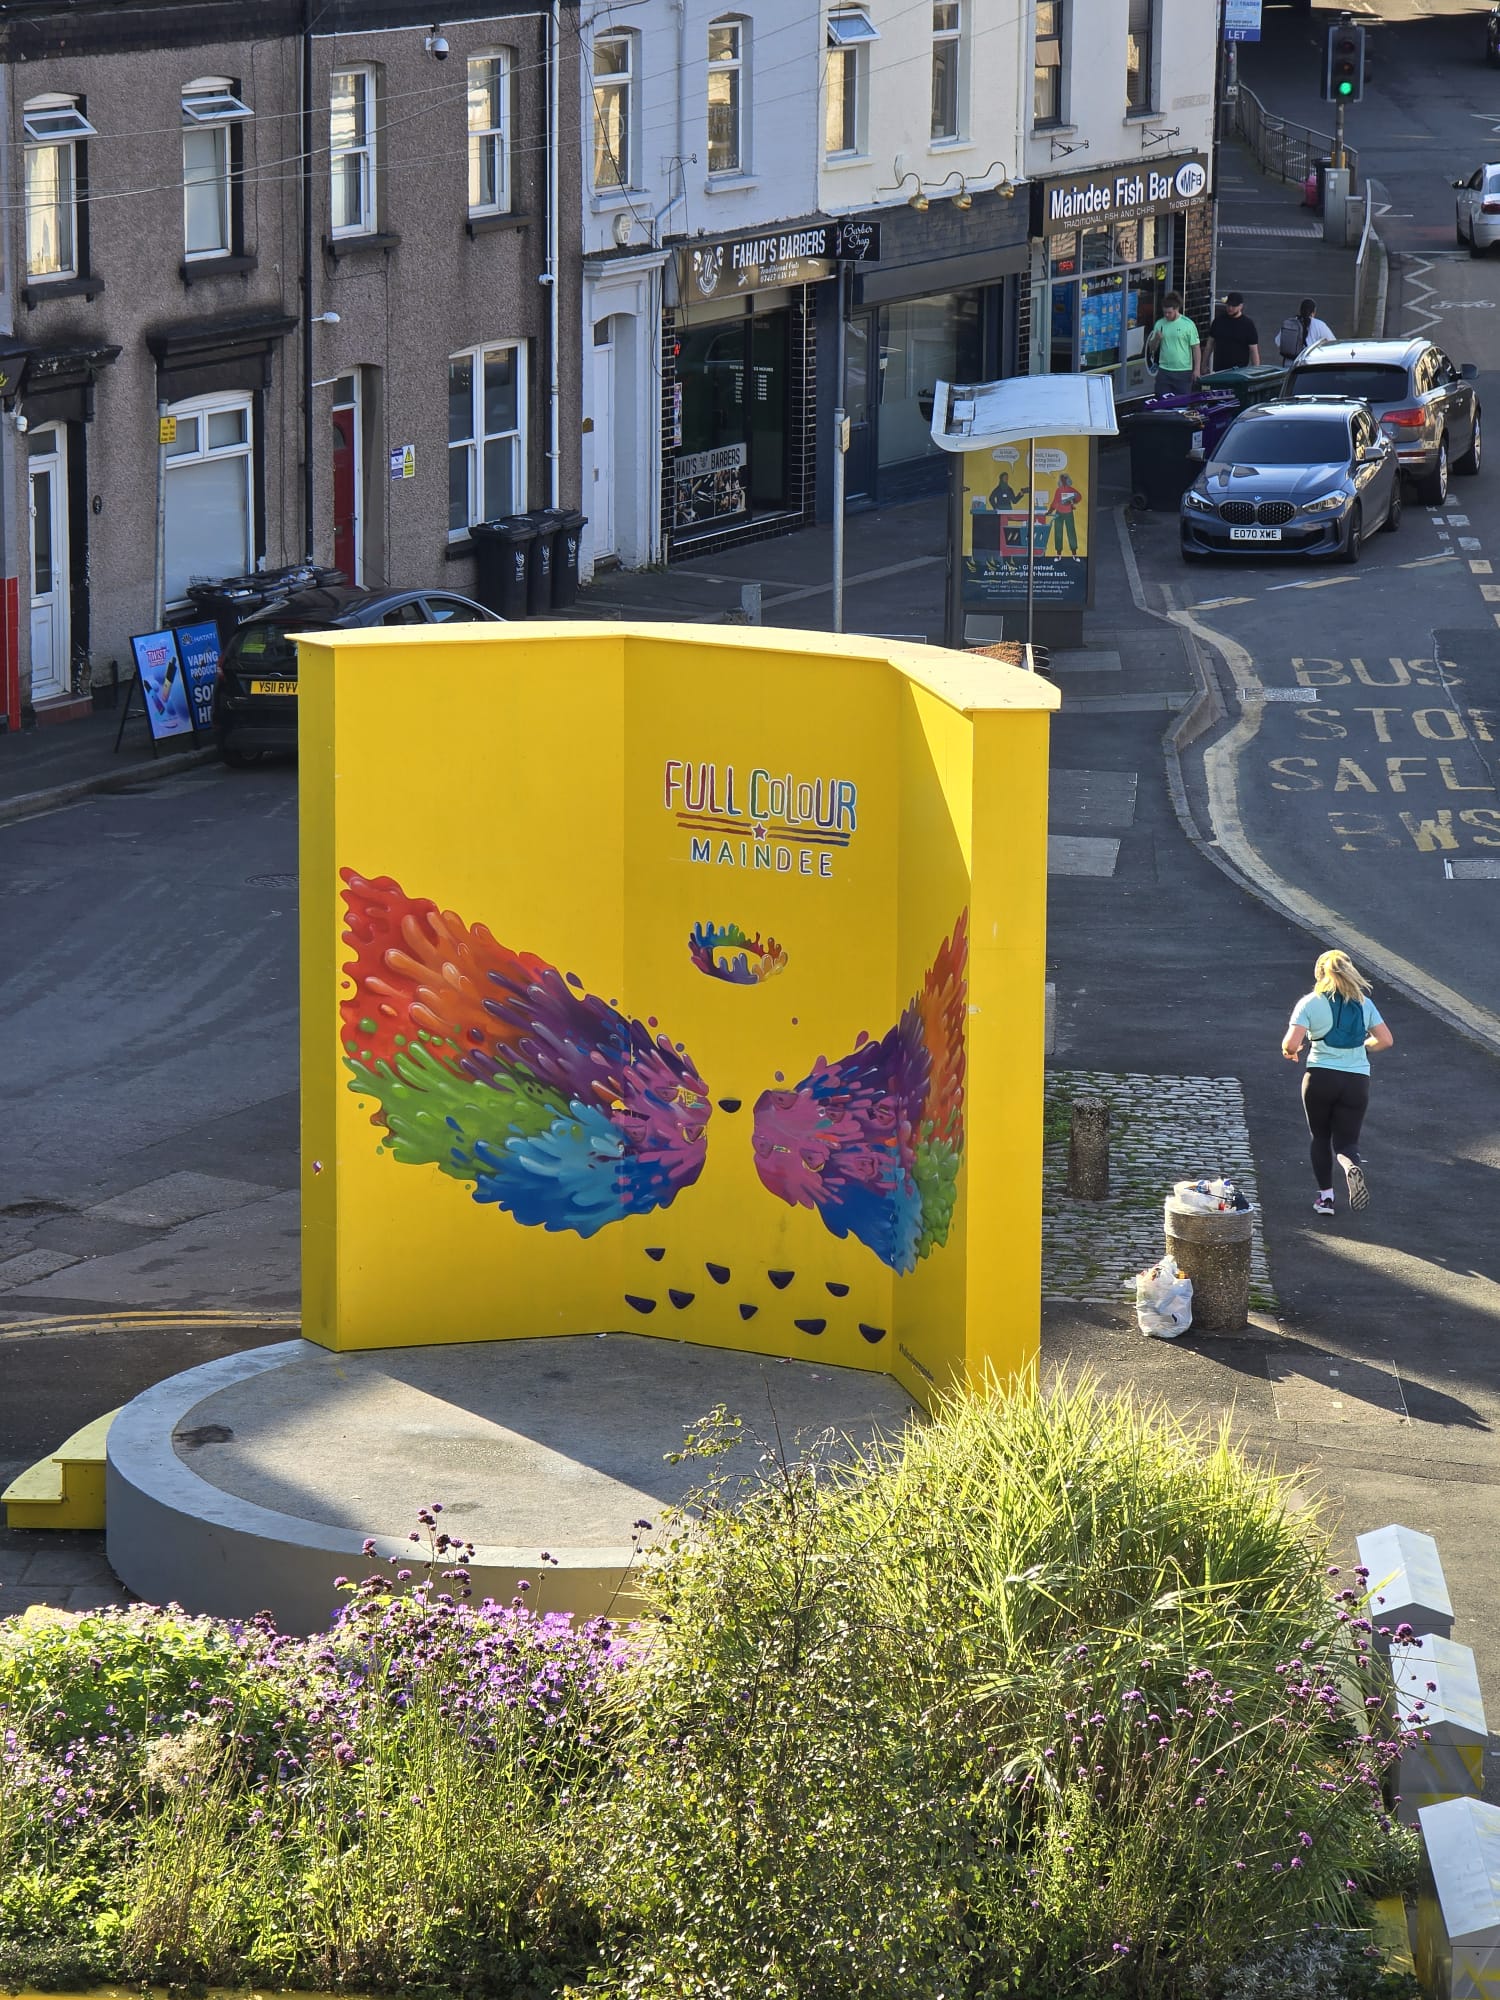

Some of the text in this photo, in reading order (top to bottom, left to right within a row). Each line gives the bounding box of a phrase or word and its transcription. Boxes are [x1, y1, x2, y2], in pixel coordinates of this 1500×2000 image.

[1228, 30, 1247, 40] LET
[1051, 172, 1173, 220] Maindee Fish Bar
[1064, 205, 1155, 229] TRADITIONAL FISH AND CHIPS
[843, 223, 873, 238] Barber
[732, 229, 826, 270] FAHAD'S BARBERS
[847, 235, 870, 254] Shop
[710, 447, 741, 470] BARBERS
[1259, 529, 1277, 539] XWE
[148, 649, 167, 661] TWIST
[187, 650, 219, 667] VAPING
[1291, 657, 1467, 687] BUS
[1268, 756, 1497, 793] SAFL
[663, 758, 743, 817] FULL
[690, 836, 834, 879] MAINDEE
